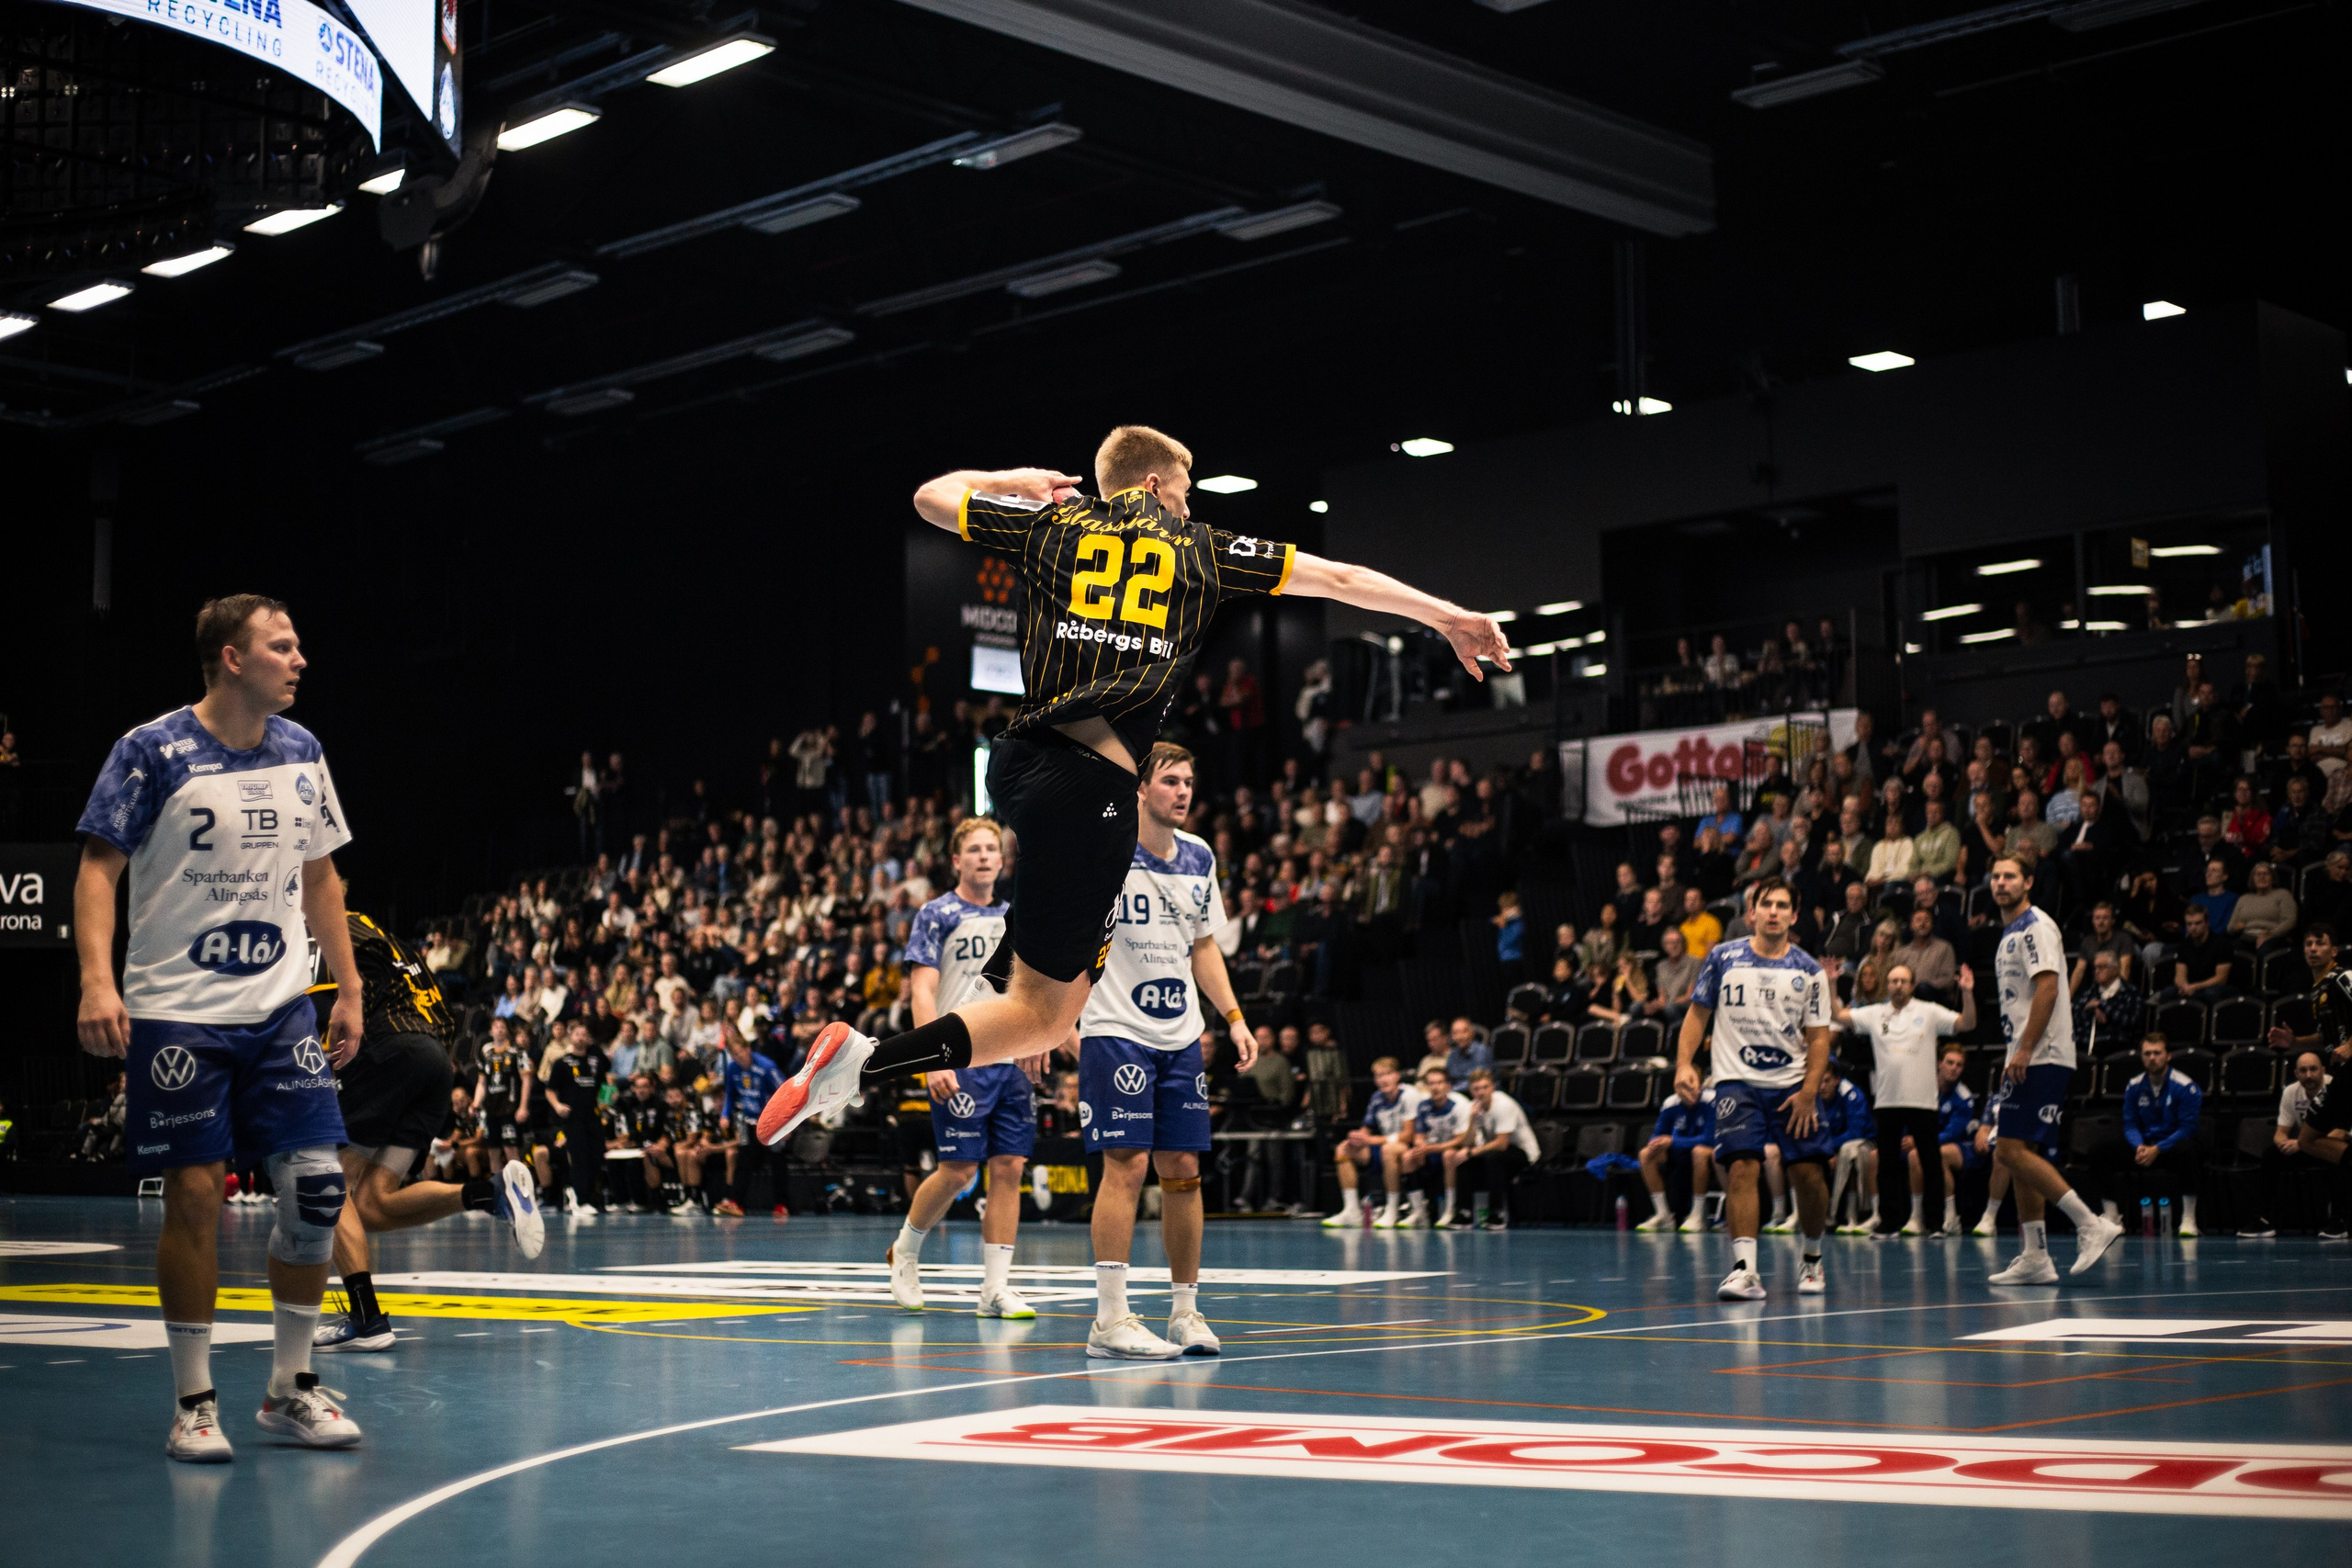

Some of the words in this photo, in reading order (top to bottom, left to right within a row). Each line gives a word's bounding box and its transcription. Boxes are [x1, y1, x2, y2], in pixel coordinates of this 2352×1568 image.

[148, 0, 282, 57] RECYCLING
[335, 30, 375, 97] STENA
[1068, 534, 1176, 630] 22
[1056, 620, 1142, 651] Råbergs
[1148, 637, 1174, 660] Bil
[172, 738, 195, 748] INTER
[175, 743, 199, 755] SPORT
[187, 762, 224, 773] Kempa
[189, 807, 216, 851] 2
[240, 808, 279, 830] TB
[240, 841, 279, 850] GRUPPEN
[182, 868, 269, 886] Sparbanken
[0, 872, 44, 905] va
[204, 887, 268, 906] Alingsås
[1117, 894, 1150, 925] 19
[0, 914, 42, 931] rona
[956, 936, 986, 961] 20
[1125, 937, 1178, 951] Sparbanken
[1723, 984, 1746, 1007] 11
[137, 1144, 172, 1156] Kempa
